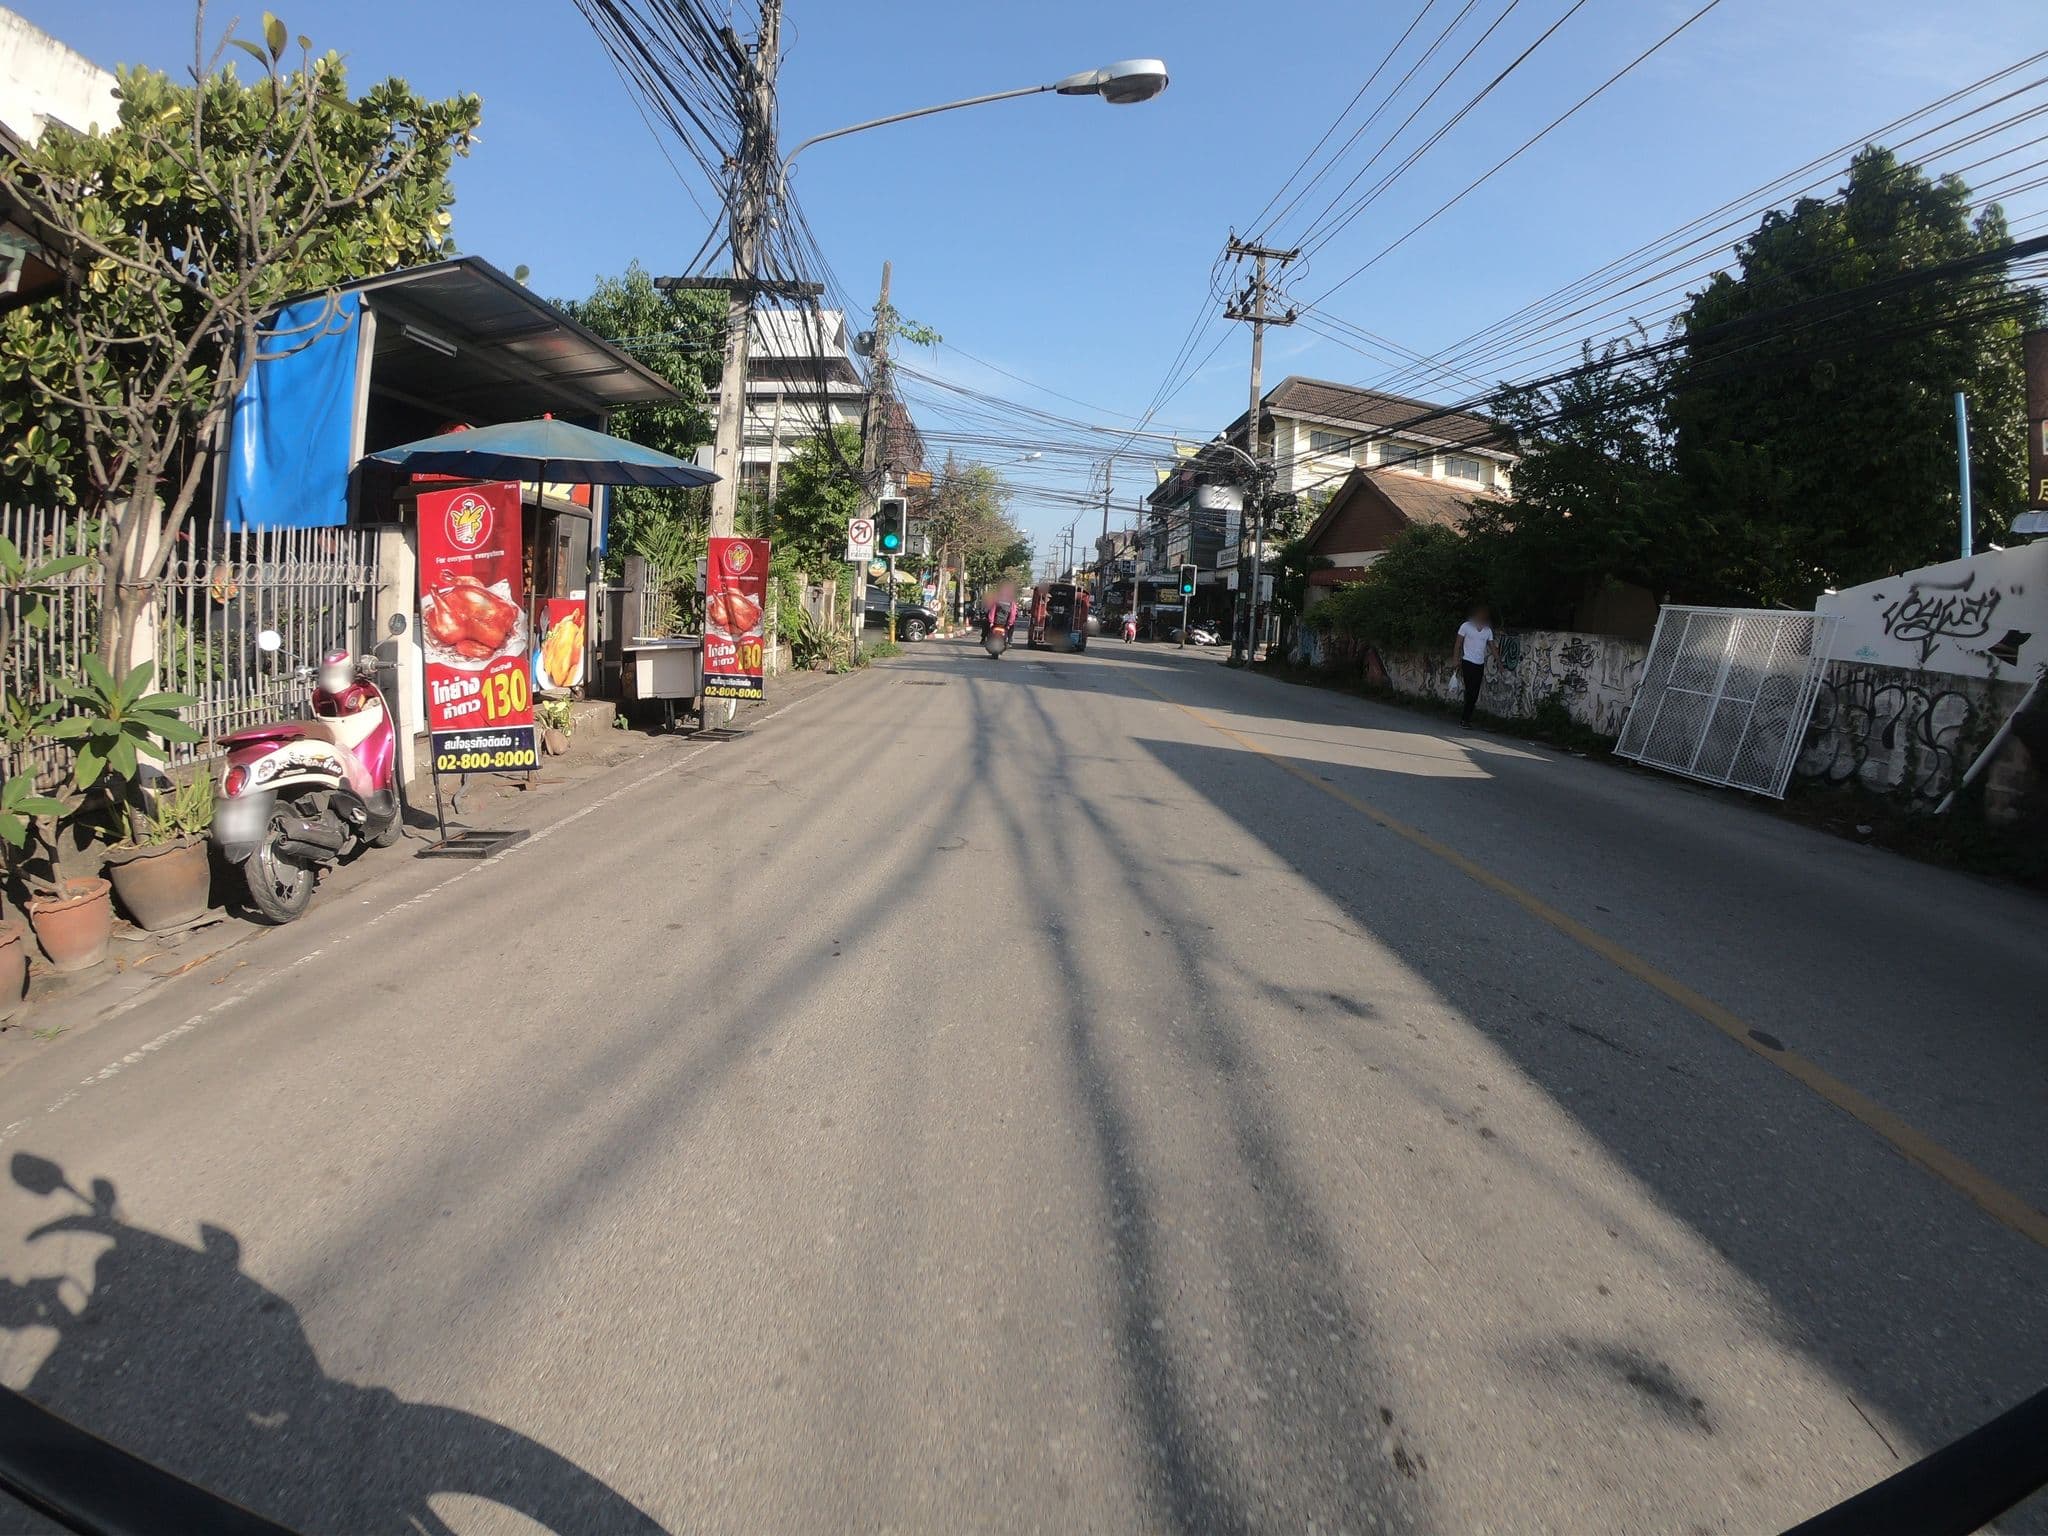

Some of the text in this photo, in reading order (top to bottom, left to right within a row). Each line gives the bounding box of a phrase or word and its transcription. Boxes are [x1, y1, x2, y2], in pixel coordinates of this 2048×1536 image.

[431, 675, 481, 706] ไก่ย่าง
[705, 686, 762, 698] 02-800-8000
[443, 699, 481, 720] ห้าดาว
[437, 749, 535, 770] 02-800-8000
